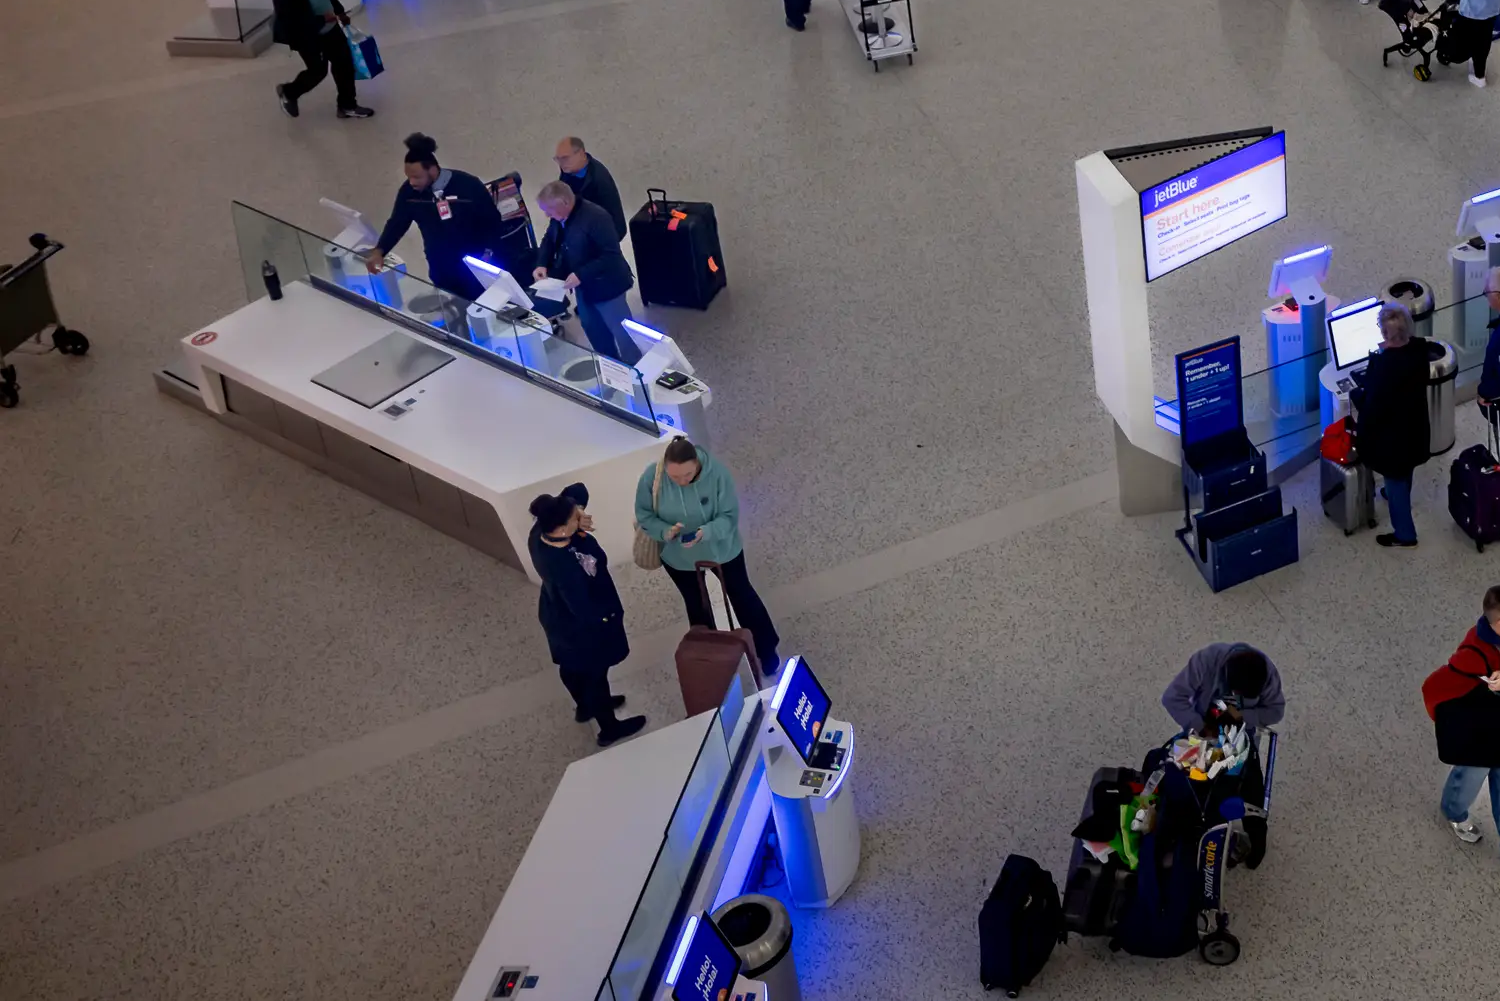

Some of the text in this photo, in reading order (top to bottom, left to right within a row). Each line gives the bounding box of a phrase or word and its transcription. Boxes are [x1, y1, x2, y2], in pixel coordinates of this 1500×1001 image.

[1154, 178, 1198, 208] jetBlue
[1157, 196, 1220, 230] Start here
[1157, 225, 1181, 239] Check-in
[1183, 216, 1200, 227] Select
[1216, 202, 1229, 212] Print
[1229, 198, 1239, 206] bag
[1239, 193, 1250, 202] tags
[1190, 371, 1209, 382] under
[1219, 363, 1230, 372] up!
[793, 691, 808, 720] Hello!
[800, 700, 814, 731] ¡Hola!
[1203, 840, 1218, 900] smartecarte
[694, 954, 712, 991] Hello!
[702, 964, 719, 1001] ¡Hola!
